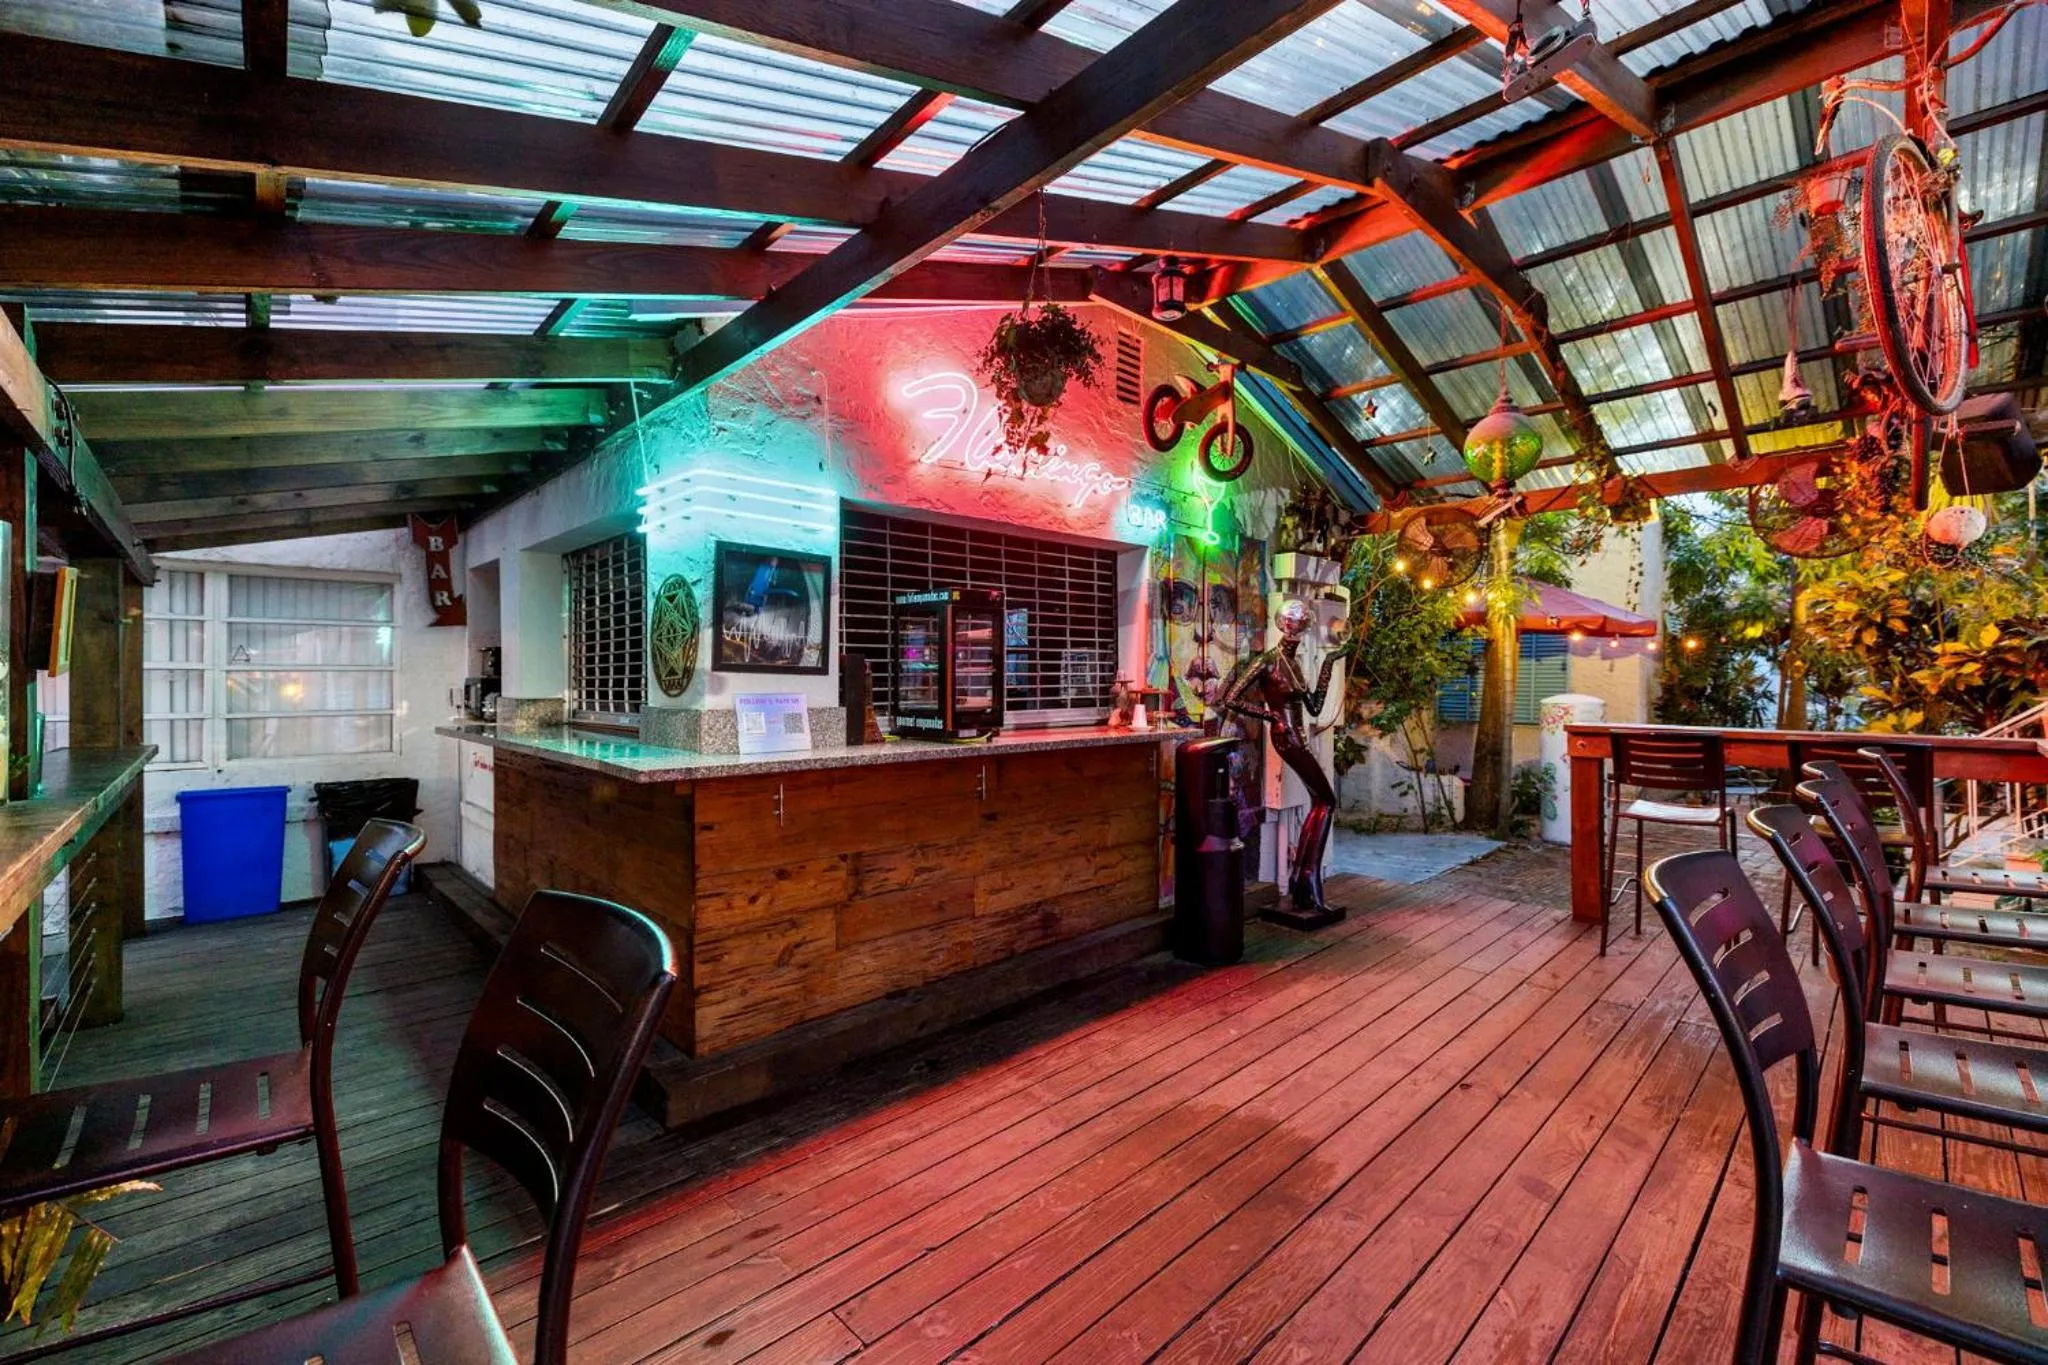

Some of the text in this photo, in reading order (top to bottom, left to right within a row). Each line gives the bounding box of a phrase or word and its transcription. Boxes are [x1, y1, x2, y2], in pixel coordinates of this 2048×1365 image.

[901, 371, 1131, 508] Flamingo
[1128, 504, 1168, 530] BAR
[428, 536, 453, 606] BAR
